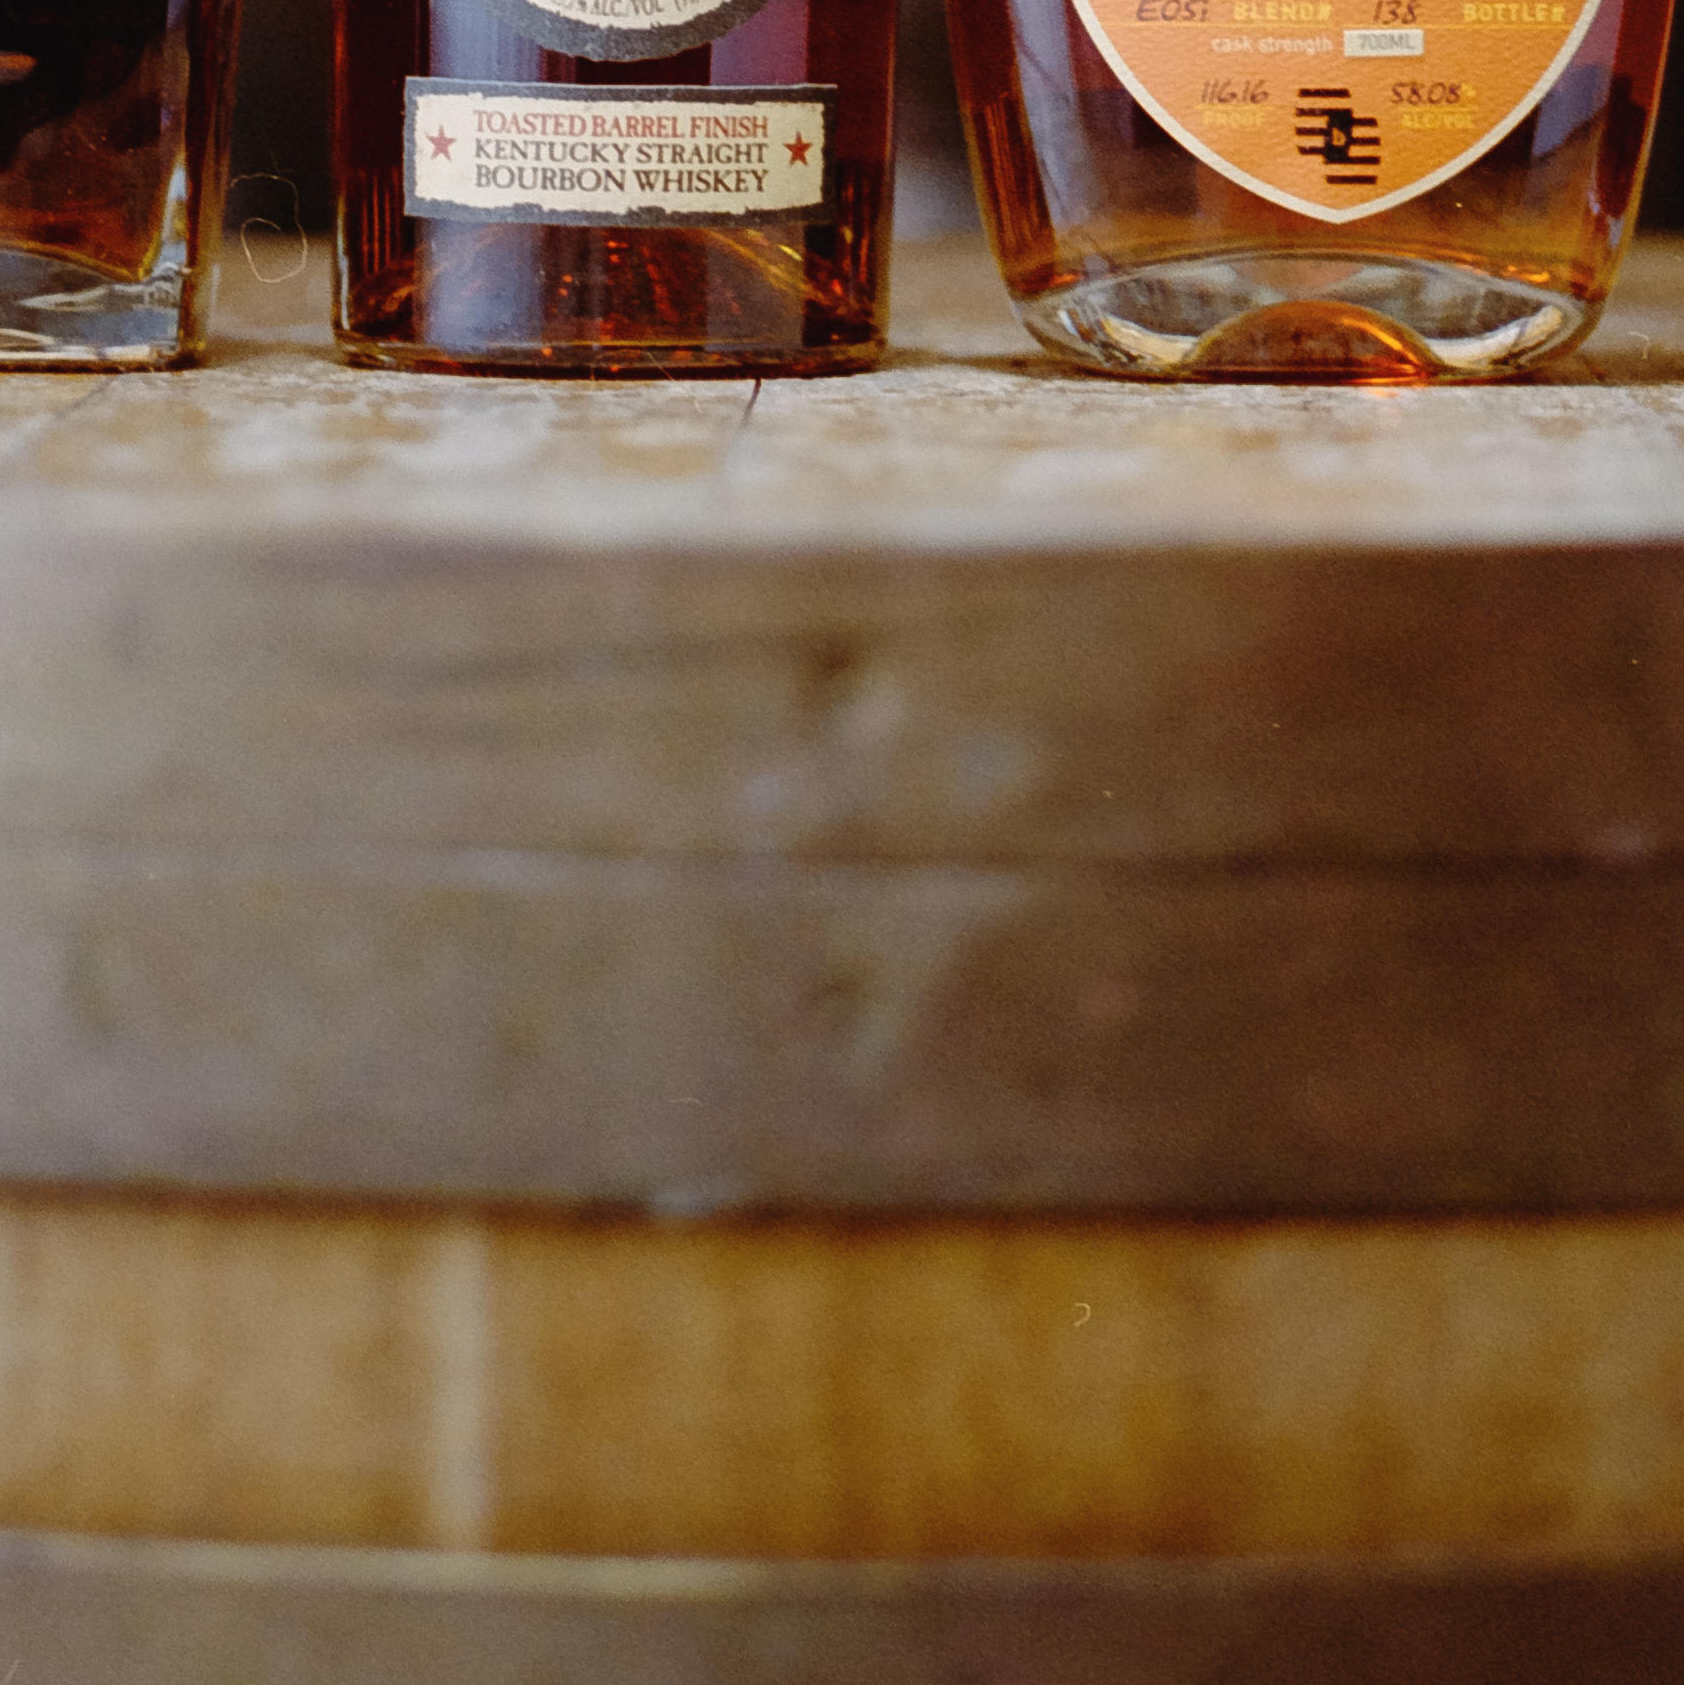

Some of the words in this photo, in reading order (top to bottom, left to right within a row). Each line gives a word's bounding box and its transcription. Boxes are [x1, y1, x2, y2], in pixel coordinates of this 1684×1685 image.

[1211, 36, 1253, 54] cask
[1257, 36, 1334, 56] strength
[473, 109, 587, 138] TOASTED
[590, 113, 682, 139] BARREL
[689, 115, 770, 140] FINISH
[473, 138, 630, 165] KENTUCKY
[635, 141, 769, 166] STRAIGHT
[474, 165, 628, 193] BOURBON
[633, 167, 770, 195] WHISKEY
